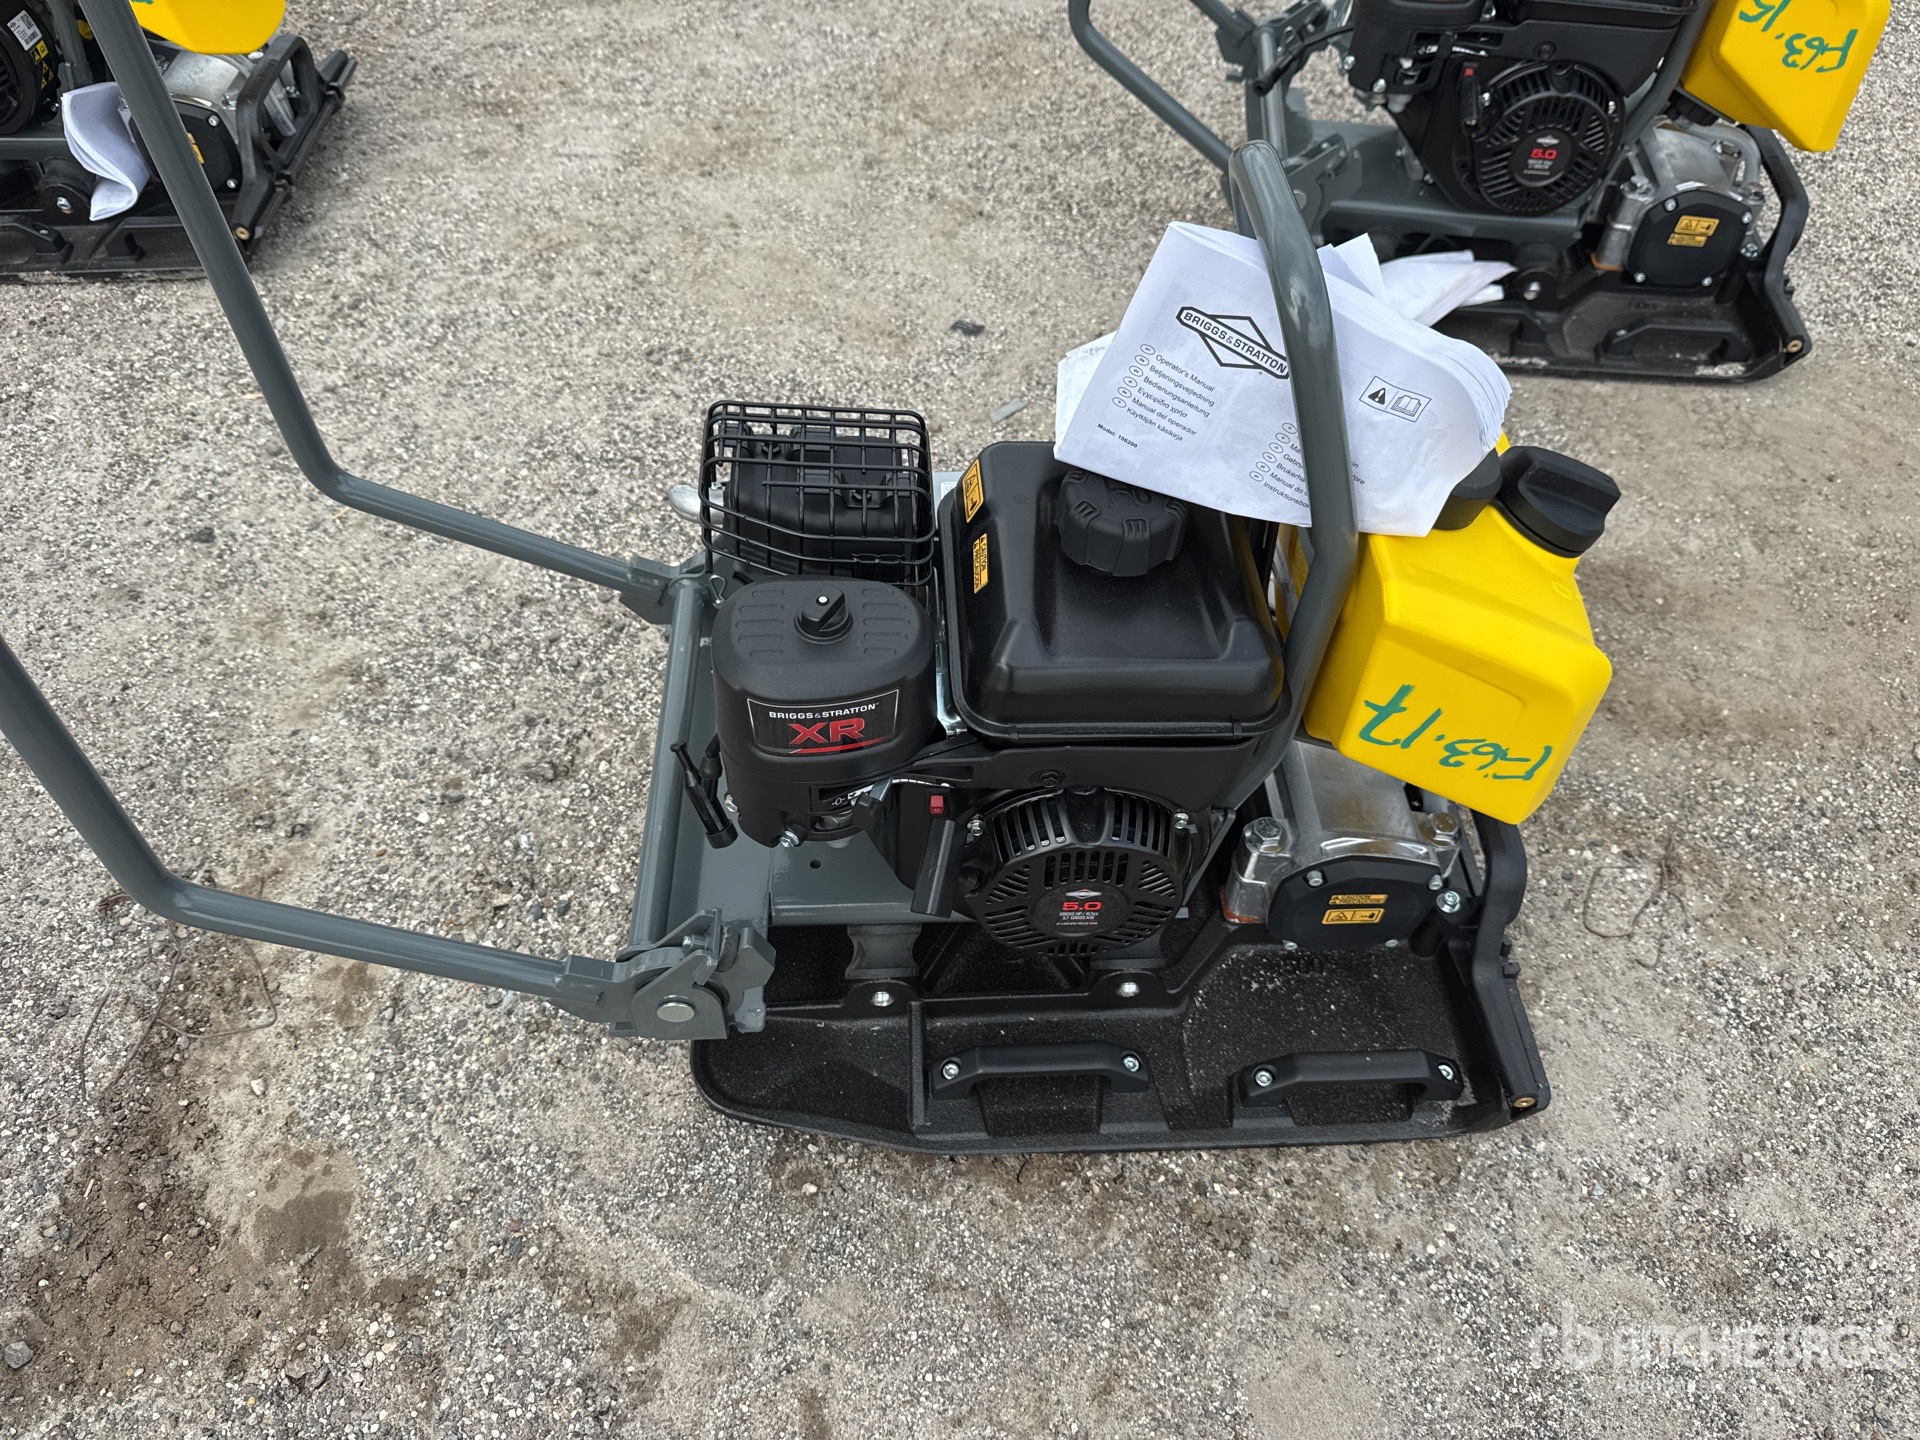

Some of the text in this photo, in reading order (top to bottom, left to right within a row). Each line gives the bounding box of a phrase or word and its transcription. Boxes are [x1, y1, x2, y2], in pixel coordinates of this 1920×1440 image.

[1155, 354, 1189, 378] Operator's
[1190, 374, 1216, 392] Manual
[1143, 376, 1210, 418] Bedienungsanleitung
[1132, 397, 1156, 415] Manual
[1156, 410, 1168, 420] del
[1167, 417, 1197, 436] operador
[1269, 472, 1296, 490] Manual
[1294, 486, 1304, 494] do
[787, 717, 865, 745] XR
[1062, 902, 1102, 911] 5.0
